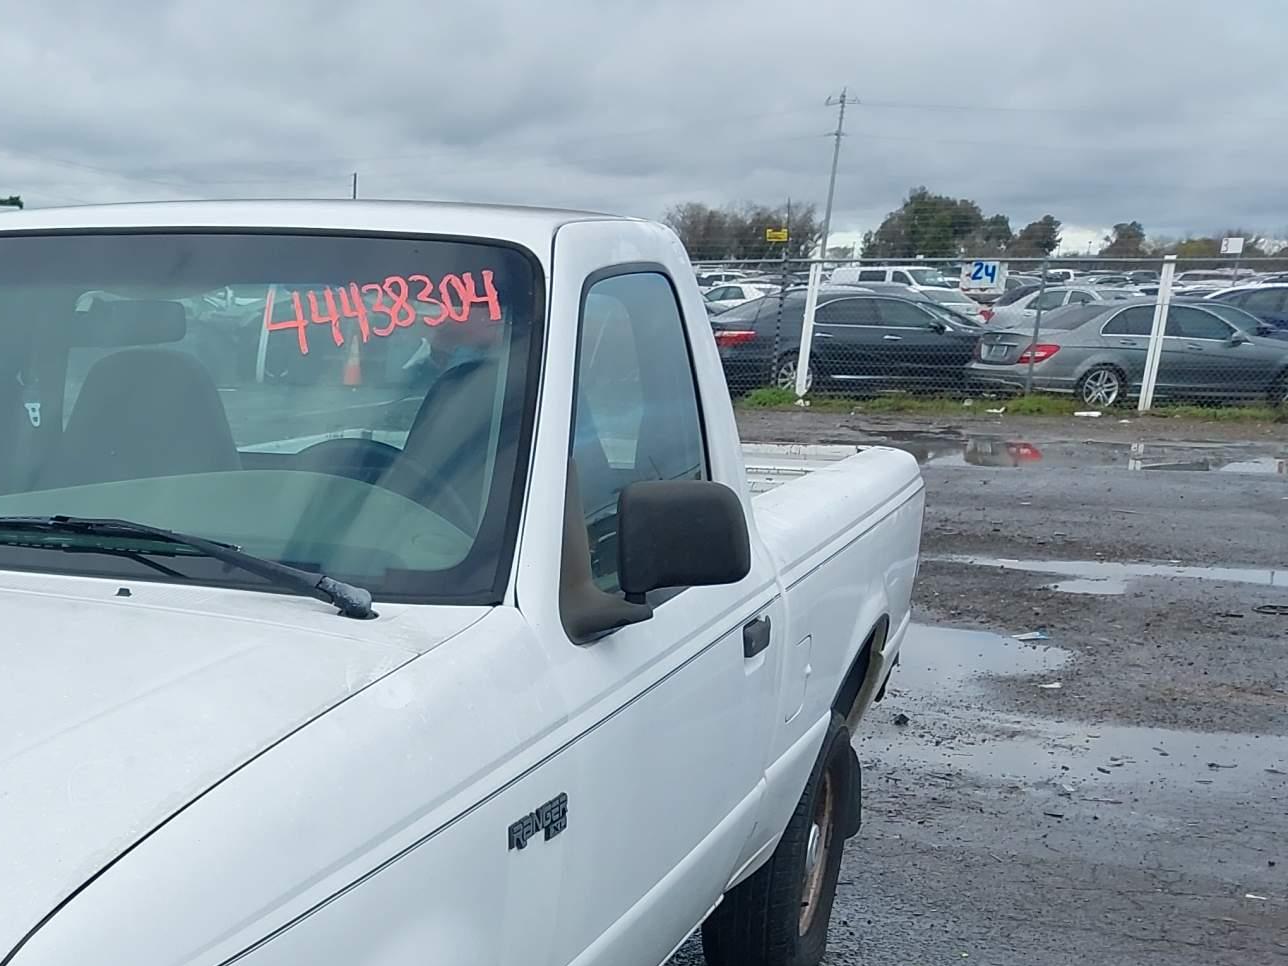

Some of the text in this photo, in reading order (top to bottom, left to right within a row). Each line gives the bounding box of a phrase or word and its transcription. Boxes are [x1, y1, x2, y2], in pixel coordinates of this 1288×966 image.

[971, 261, 997, 284] 24
[264, 269, 502, 355] 44438304
[508, 792, 568, 850] RANGER
